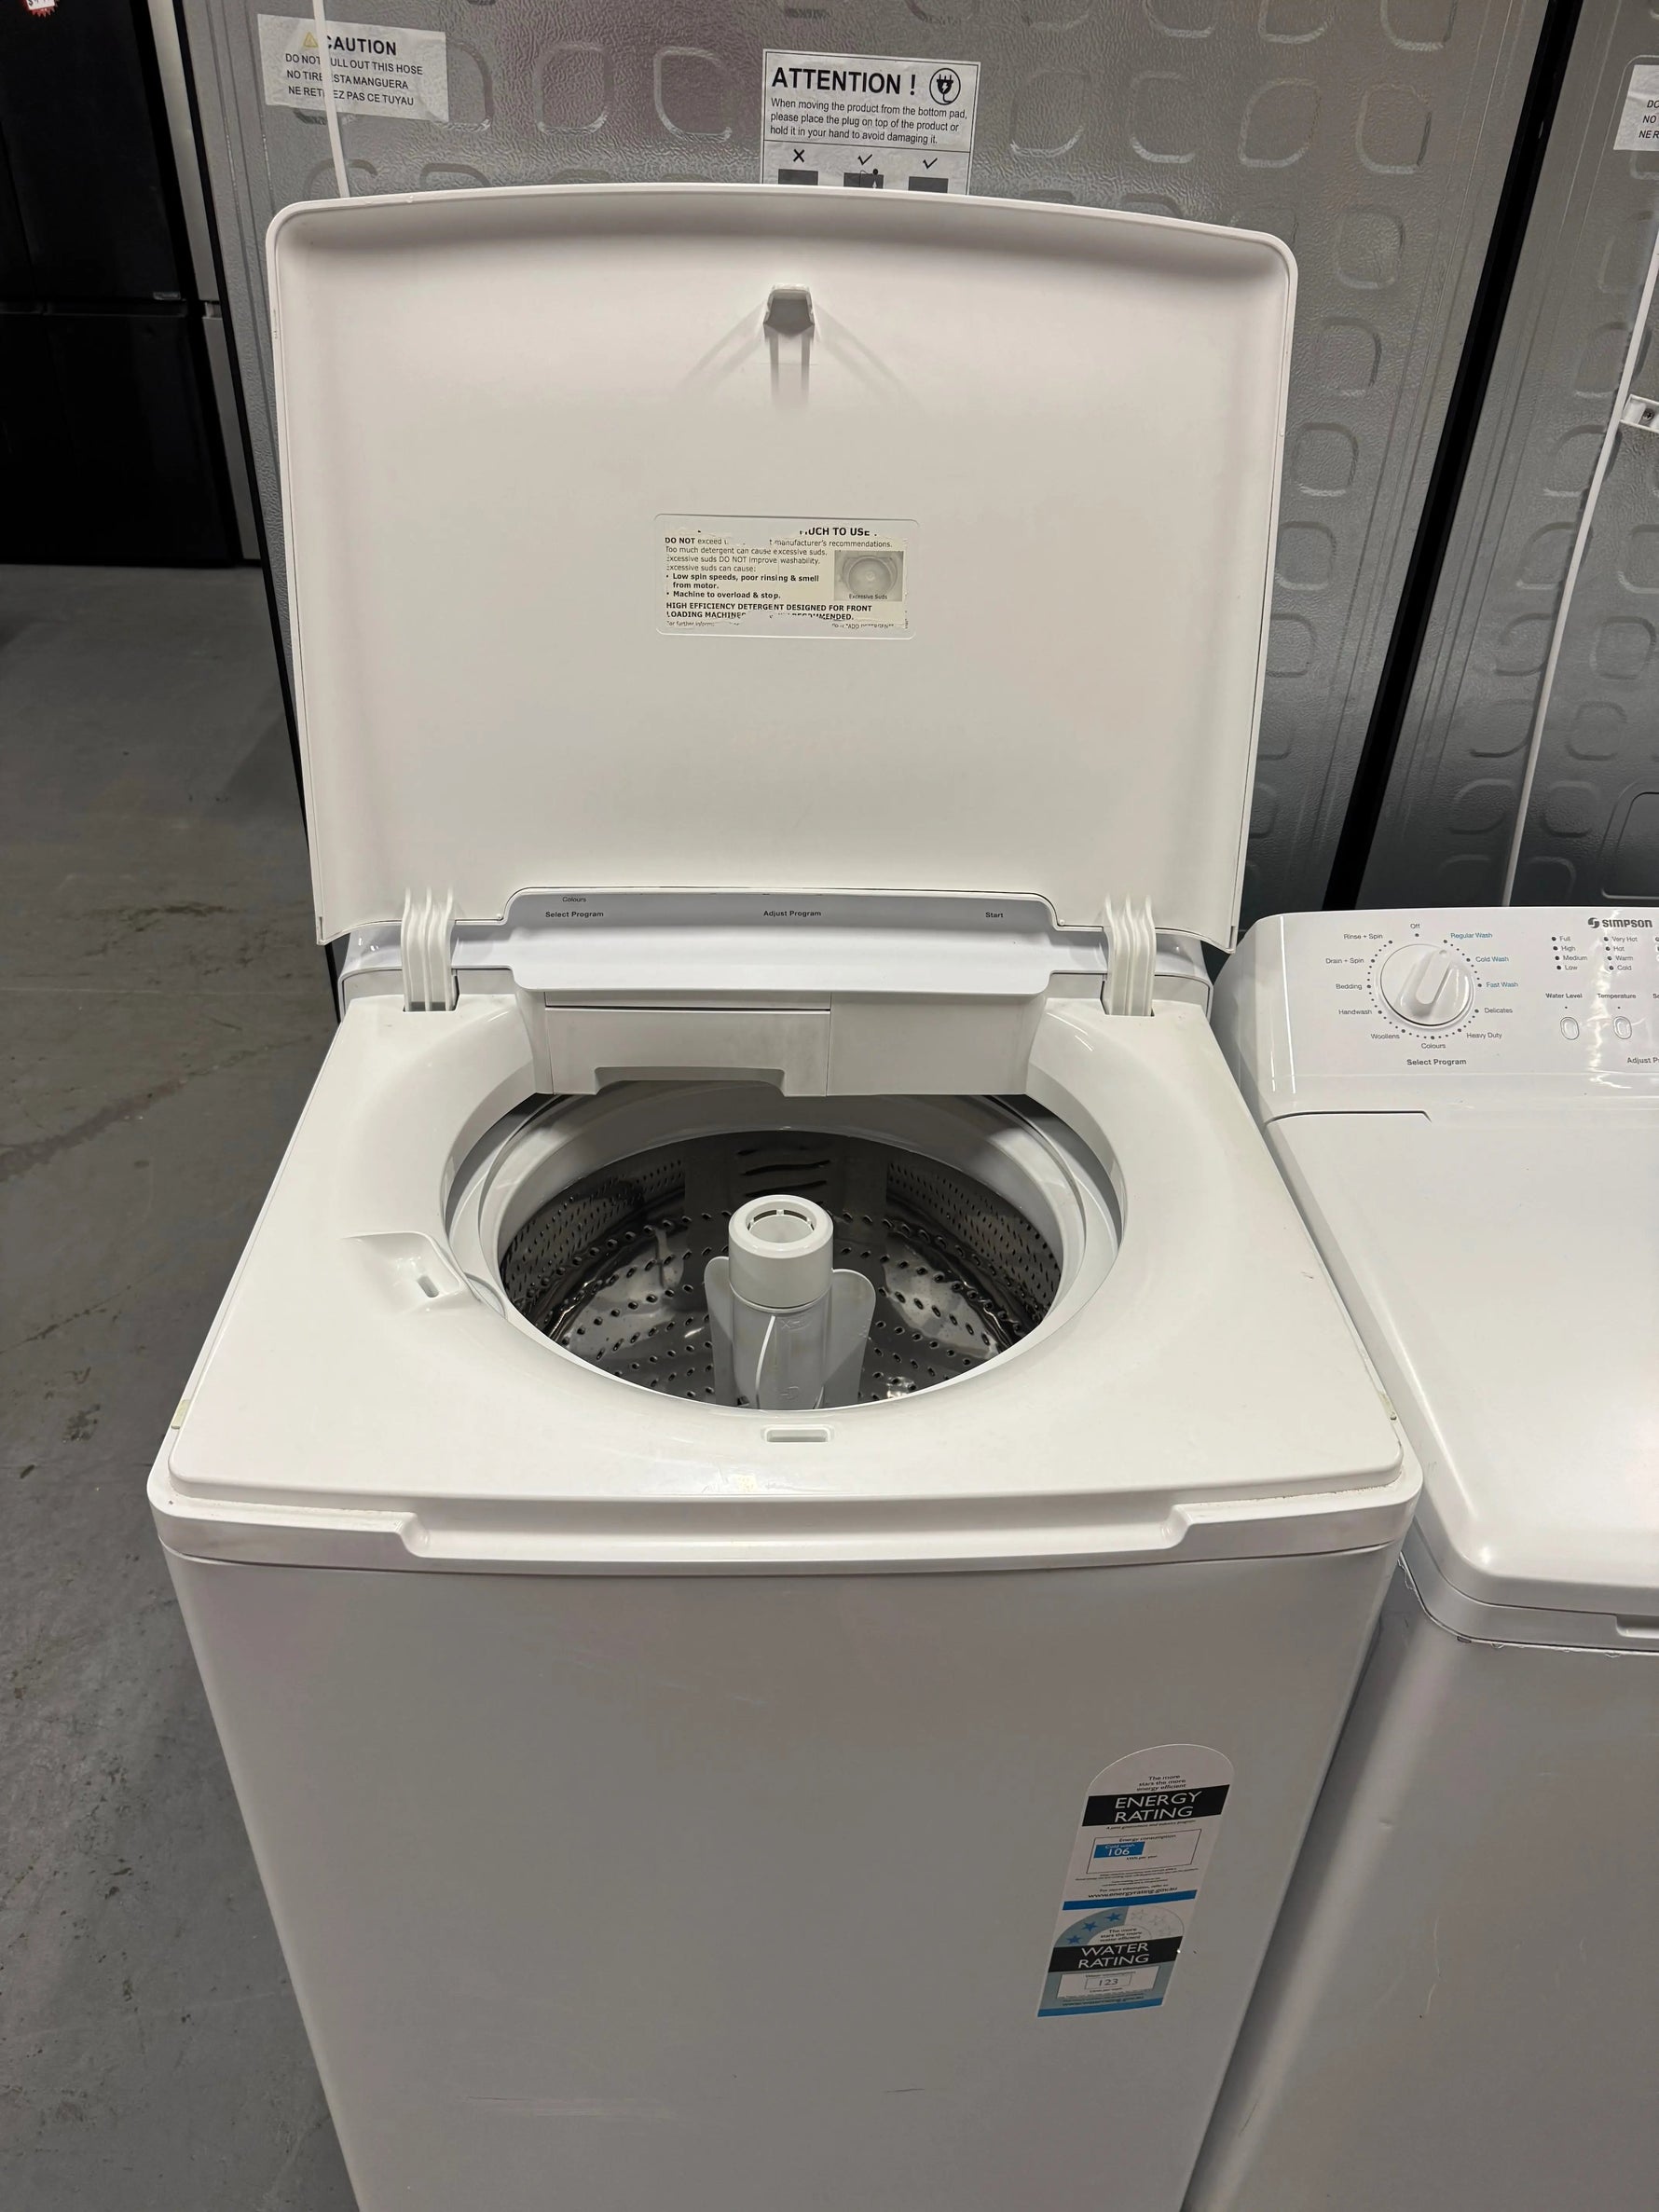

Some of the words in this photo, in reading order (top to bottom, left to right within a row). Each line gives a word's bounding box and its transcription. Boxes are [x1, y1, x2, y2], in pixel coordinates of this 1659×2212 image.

[285, 53, 299, 63] DO
[330, 58, 349, 69] ULL
[350, 60, 370, 70] OUT
[372, 62, 394, 74] THIS
[396, 64, 423, 76] HOSE
[287, 70, 301, 79] NO
[332, 74, 352, 84] STA
[353, 76, 408, 89] MANGUERA
[772, 66, 901, 95] ATTENTION
[288, 86, 301, 96] NE
[347, 91, 365, 102] PAS
[368, 93, 380, 103] CE
[382, 94, 414, 106] TUYAU
[771, 97, 796, 109] When
[798, 100, 830, 113] moving
[831, 100, 845, 110] the
[846, 102, 879, 116] product
[881, 103, 900, 114] from
[902, 104, 916, 116] the
[918, 105, 947, 118] bottom
[949, 108, 968, 121] pad,
[770, 112, 799, 125] please
[801, 113, 824, 127] place
[826, 114, 839, 124] the
[842, 116, 860, 129] plug
[862, 117, 873, 127] on
[874, 117, 888, 131] top
[890, 118, 899, 129] of
[901, 118, 914, 130] the
[916, 119, 949, 133] product
[950, 122, 960, 131] or
[1642, 115, 1657, 124] NO
[770, 125, 788, 136] hold
[790, 126, 796, 136] it
[798, 127, 806, 136] in
[808, 129, 827, 139] your
[829, 128, 850, 139] hand
[851, 130, 860, 140] to
[862, 130, 885, 141] avoid
[887, 131, 928, 145] damaging
[1638, 130, 1652, 138] NE
[832, 528, 847, 536] TO
[829, 540, 892, 548] recommendations.
[700, 547, 734, 555] detergent
[709, 573, 738, 582] speeds,
[761, 574, 788, 583] rinsing
[789, 910, 822, 918] Program
[1602, 919, 1653, 928] SIMPSON
[1434, 1058, 1467, 1067] Program
[1115, 1791, 1202, 1809] ENERGY
[1114, 1806, 1194, 1823] RATING
[1108, 1848, 1130, 1856] 106
[1081, 1942, 1149, 1957] WATER
[1077, 1953, 1150, 1969] RATING
[1098, 1978, 1119, 1986] 123
